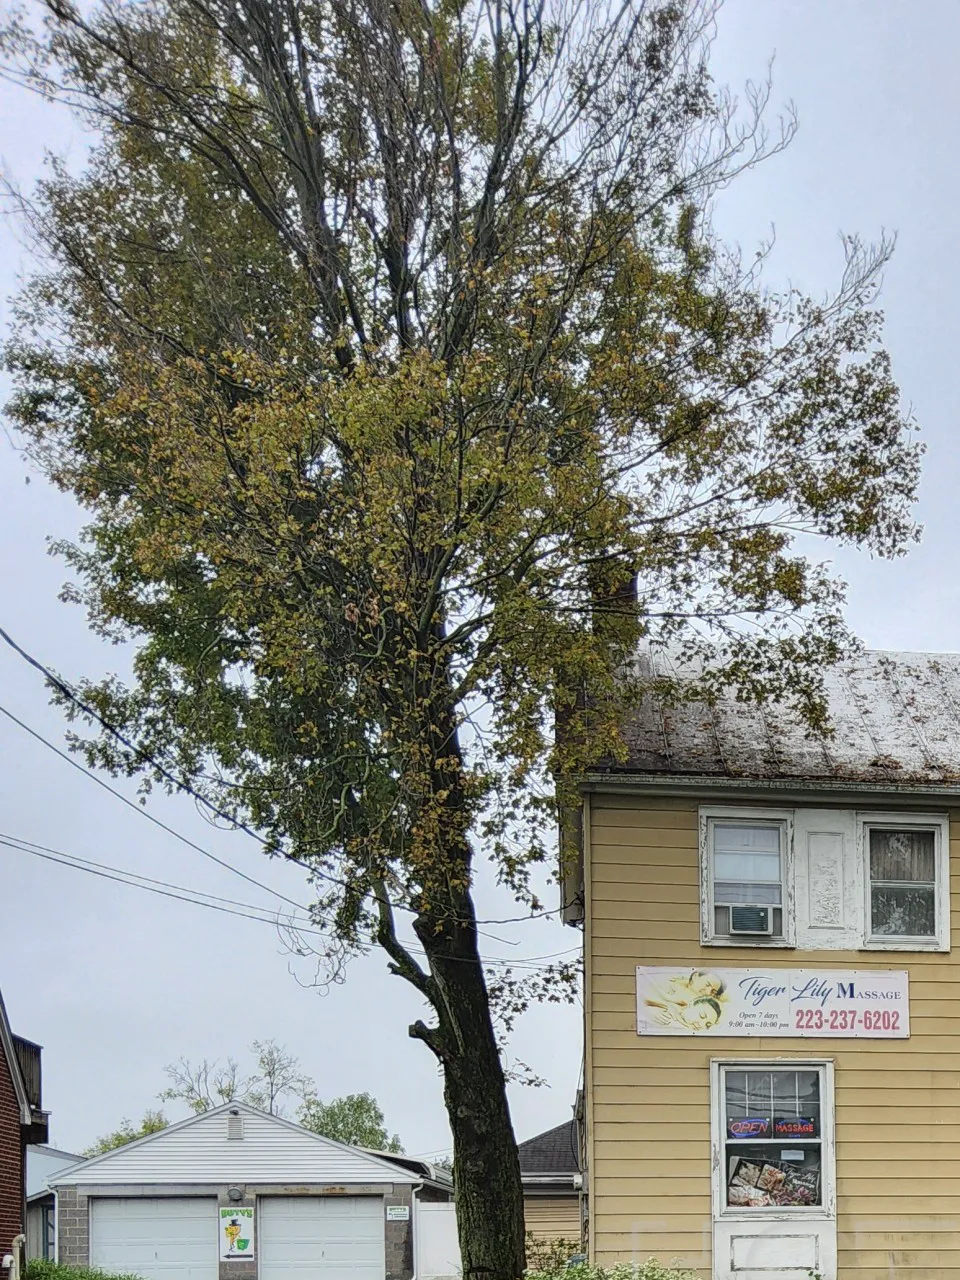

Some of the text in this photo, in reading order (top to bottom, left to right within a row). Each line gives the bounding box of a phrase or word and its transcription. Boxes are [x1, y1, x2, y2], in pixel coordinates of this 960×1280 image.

[739, 976, 786, 1006] Tiger
[791, 977, 833, 1007] Lily
[739, 1011, 779, 1020] Open 7 days
[795, 1009, 900, 1031] 223-237-6202
[731, 1122, 768, 1132] OPEN
[775, 1123, 814, 1132] MASSAGE
